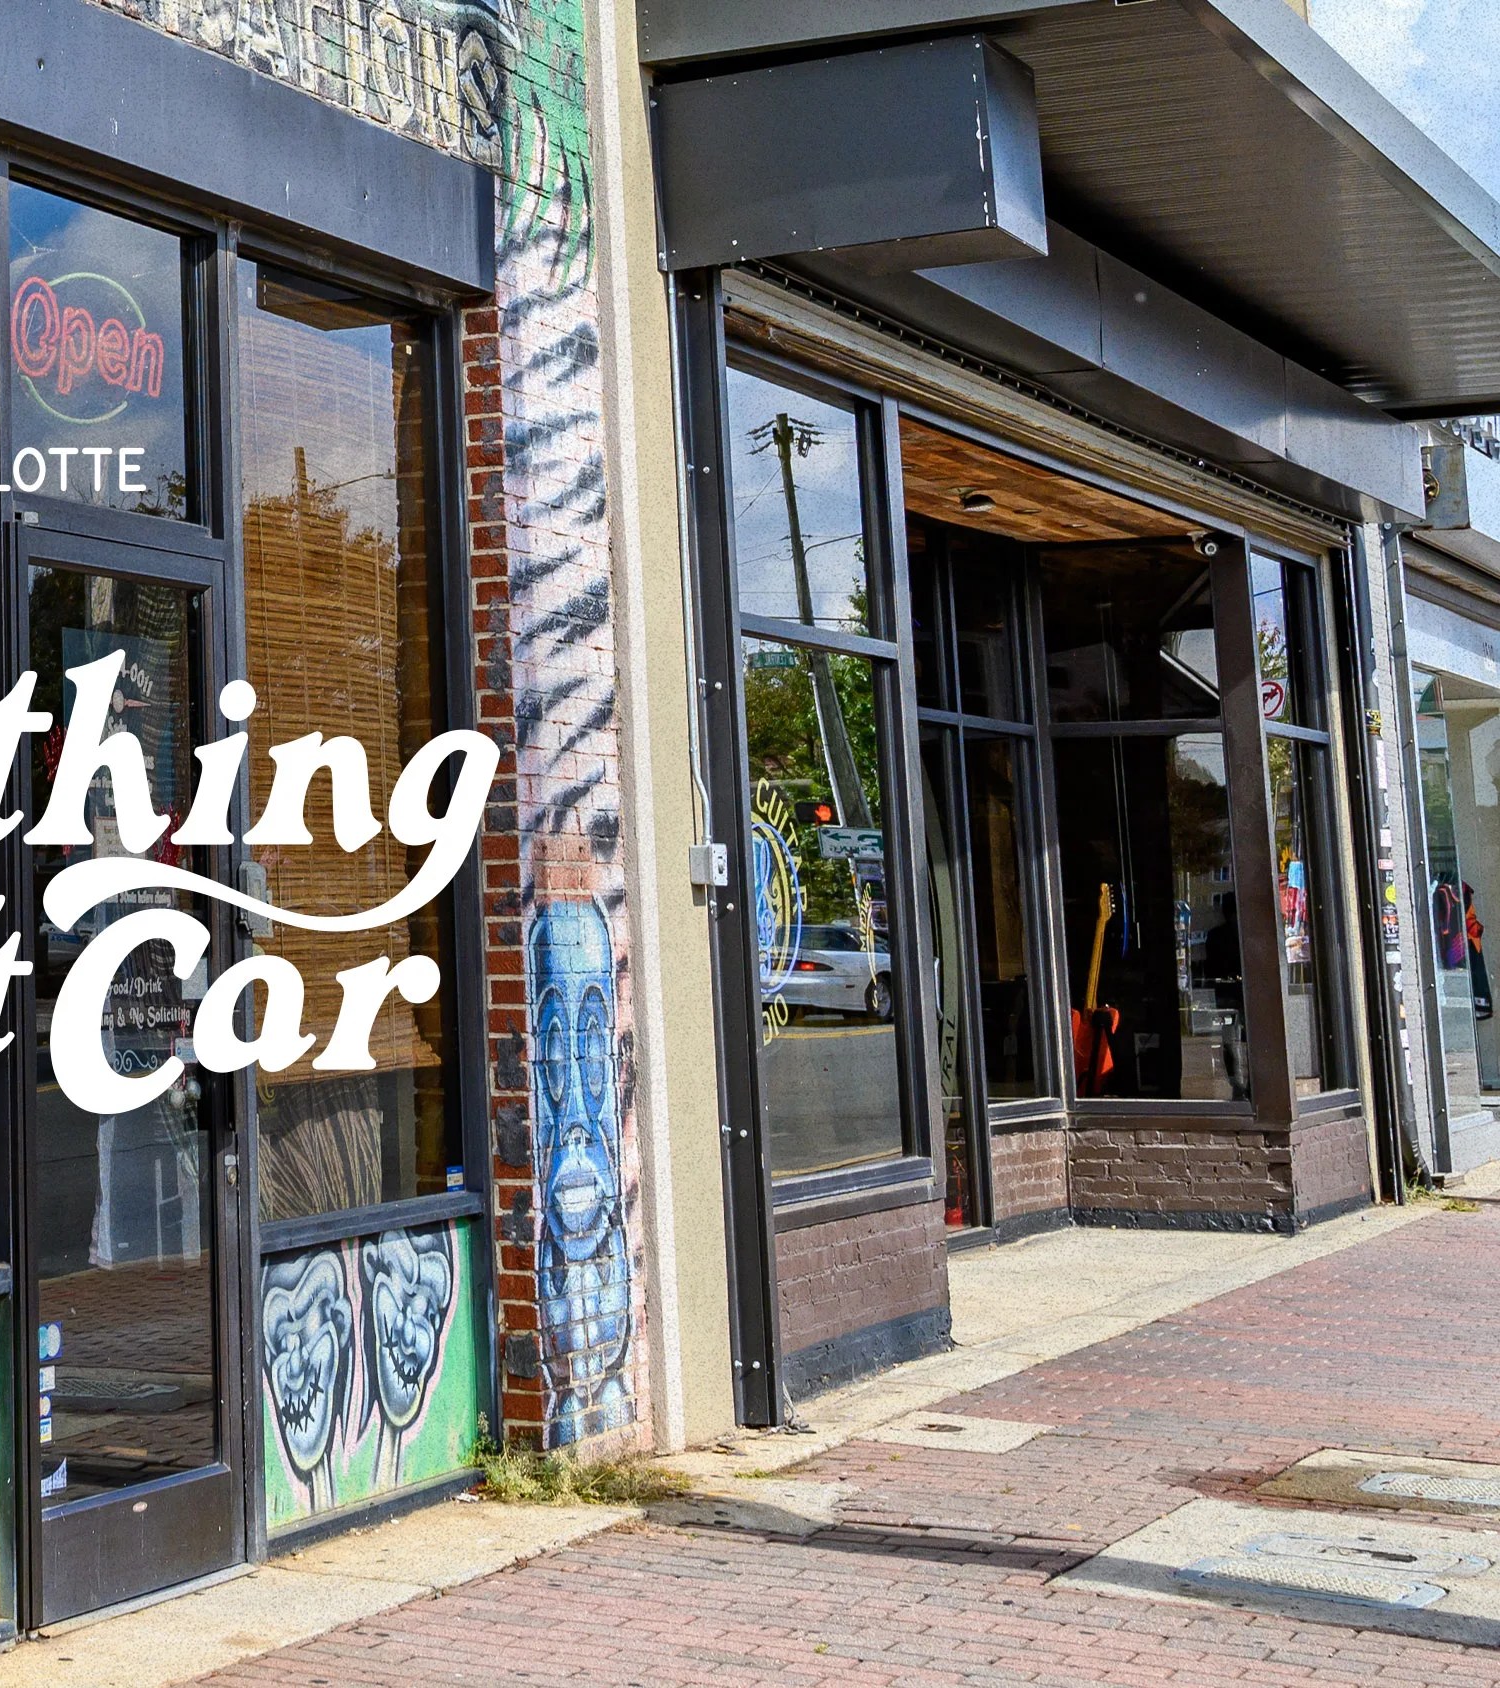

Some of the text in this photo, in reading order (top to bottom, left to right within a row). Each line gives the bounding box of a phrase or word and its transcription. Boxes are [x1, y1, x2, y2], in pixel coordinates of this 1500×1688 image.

[10, 276, 164, 398] Open
[756, 777, 808, 914] GUITAR
[128, 1006, 145, 1029] No
[146, 1005, 191, 1028] Soliciting
[762, 993, 788, 1046] DIO
